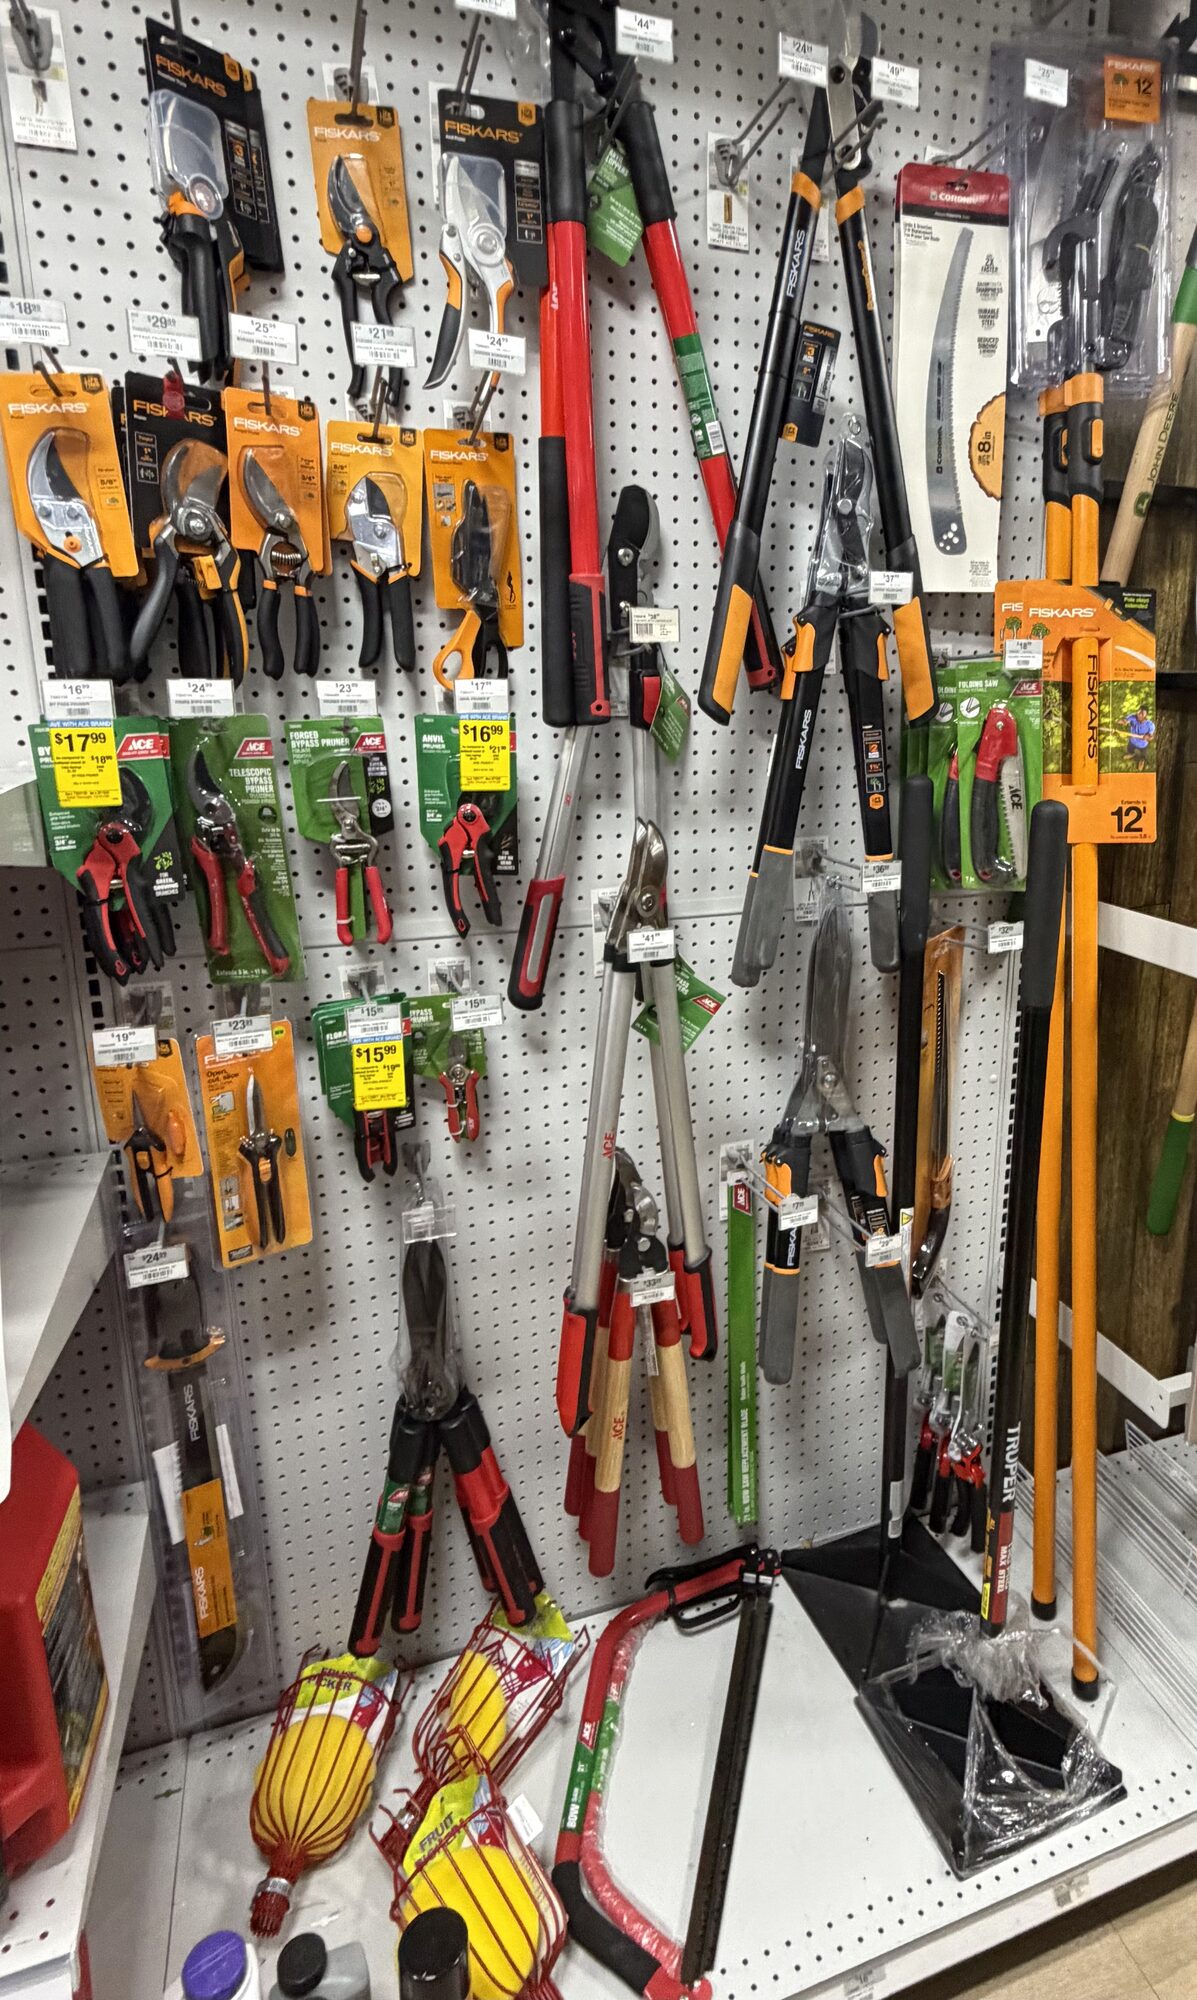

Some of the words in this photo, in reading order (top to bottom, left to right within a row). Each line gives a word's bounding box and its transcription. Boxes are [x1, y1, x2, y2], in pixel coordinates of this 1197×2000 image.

[156, 53, 227, 97] FISKARS
[314, 126, 381, 141] FISKARS
[444, 120, 520, 144] FISKARS
[786, 230, 806, 298] FISKARS
[8, 402, 88, 416] FISKARS
[1156, 392, 1180, 445] DEERE
[233, 416, 301, 437] FISKARS
[331, 442, 393, 457] FISKARS
[430, 450, 487, 461] FISKARS
[978, 441, 992, 453] 8
[1147, 445, 1166, 486] JOHN
[1028, 607, 1095, 618] FISKARS
[1021, 683, 1038, 691] ACE
[1087, 654, 1098, 760] FISKARS
[128, 739, 154, 750] ACE
[290, 731, 319, 740] FORGED
[291, 739, 319, 748] BYPASS
[321, 738, 350, 747] PRUNER
[362, 737, 382, 745] ACE
[422, 735, 444, 743] ANVIL
[795, 709, 811, 770] FISKARS
[247, 743, 265, 751] ACE
[229, 768, 272, 777] TELESCOPIC
[245, 776, 273, 785] BYPASS
[245, 784, 274, 793] PRUNER
[1008, 785, 1023, 811] ACE
[601, 1131, 616, 1160] ACE
[737, 1188, 745, 1206] ACE
[183, 1383, 201, 1442] FISKARS
[740, 1408, 748, 1428] BLADE
[612, 1416, 625, 1441] ACE
[1003, 1421, 1021, 1503] TRUPER
[999, 1545, 1007, 1566] MAX
[997, 1569, 1006, 1594] STEEL
[191, 1566, 209, 1620] FISKARS
[582, 1722, 592, 1740] ACE
[567, 1804, 579, 1828] BOW
[419, 1811, 456, 1851] FRUIT
